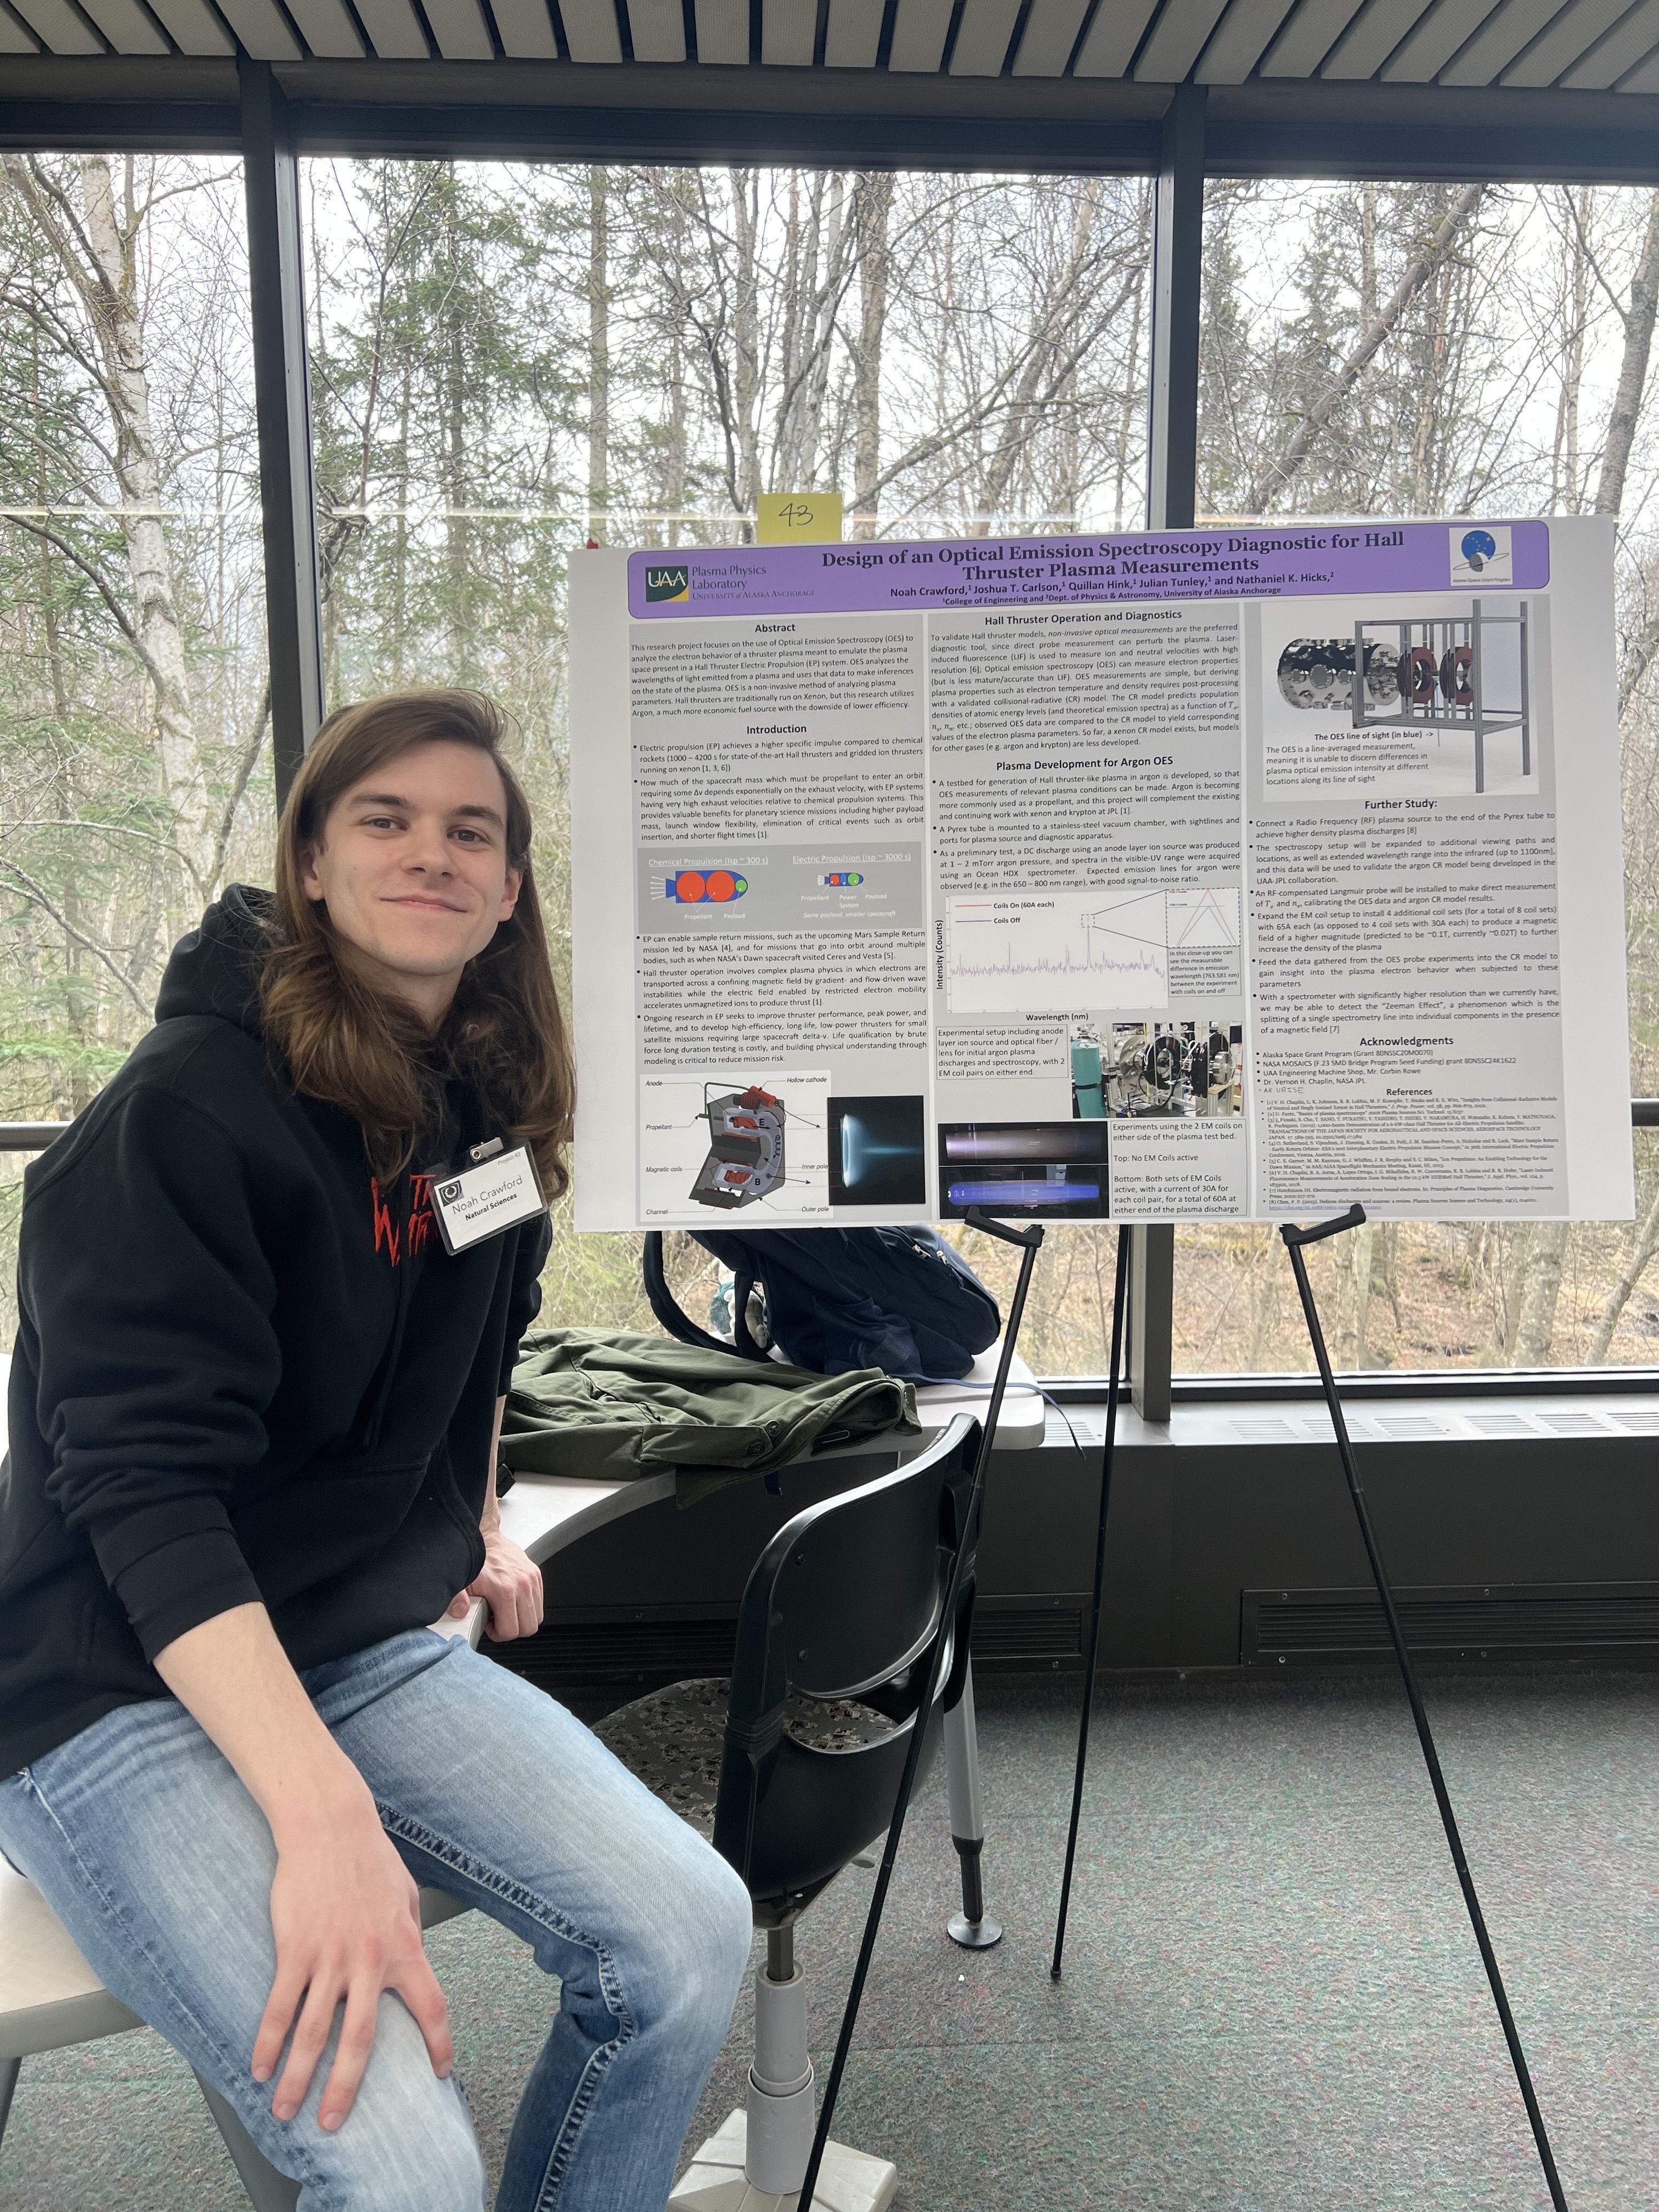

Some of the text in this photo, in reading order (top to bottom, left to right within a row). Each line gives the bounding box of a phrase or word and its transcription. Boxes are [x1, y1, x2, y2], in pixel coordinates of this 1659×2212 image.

[778, 502, 814, 527] 43
[822, 532, 1403, 568] Design of an Optical Emission Spectroscopy Diagnostic for Hall
[692, 565, 766, 577] Plasma Physics
[963, 558, 1259, 580] Thruster Plasma Measurements
[648, 571, 686, 588] UAA
[693, 579, 747, 590] Laboratory
[891, 588, 916, 596] Noah
[974, 585, 1007, 594] Joshua
[1069, 581, 1104, 591] Quillan
[1139, 579, 1167, 588] Julian
[1215, 576, 1233, 585] and
[1237, 574, 1284, 584] Nathaniel
[984, 596, 1028, 604] Engineering
[985, 617, 1003, 625] Hall
[1052, 613, 1101, 624] Operation
[1104, 612, 1122, 620] and
[1126, 611, 1182, 621] Diagnostics
[778, 639, 803, 647] Optical
[885, 635, 904, 643] (OES)
[747, 725, 806, 734] Introduction
[997, 757, 1173, 770] Plasma Development for Argon OES
[1365, 799, 1437, 809] Further Study:
[684, 857, 723, 867] Propulsion
[760, 855, 768, 864] s)
[821, 854, 860, 864] Propulsion
[904, 853, 911, 862] s)
[935, 920, 944, 954] (Counts)
[1360, 1037, 1453, 1047] Acknowledgments
[497, 1155, 514, 1166] Project
[452, 1175, 523, 1214] Noah Crawford
[465, 1193, 517, 1221] Natural Sciences
